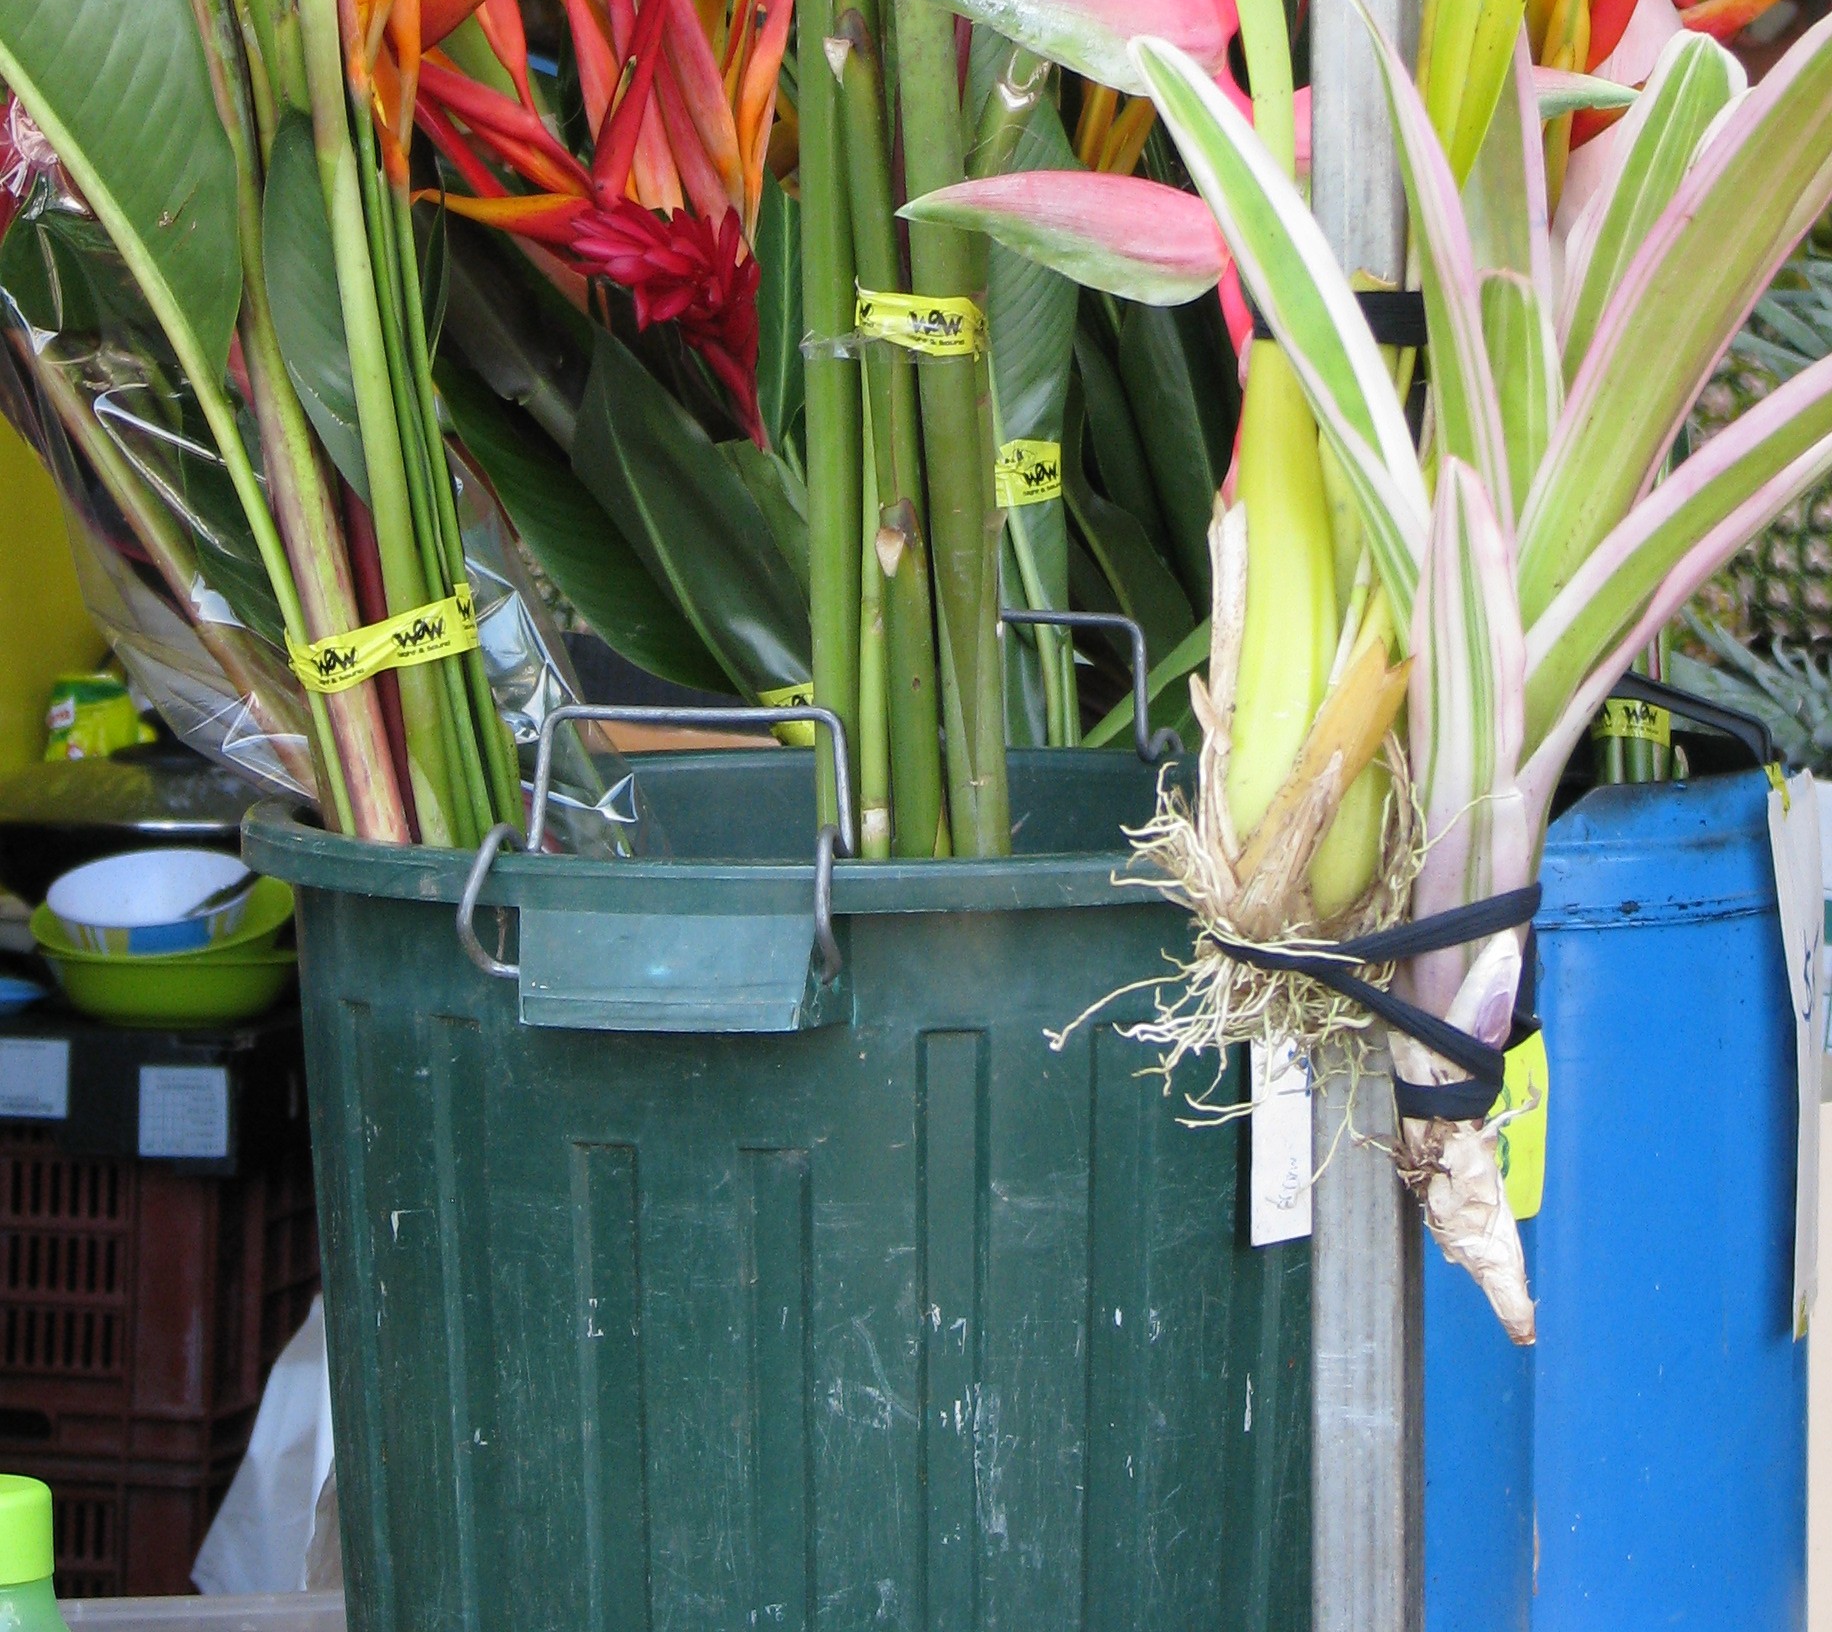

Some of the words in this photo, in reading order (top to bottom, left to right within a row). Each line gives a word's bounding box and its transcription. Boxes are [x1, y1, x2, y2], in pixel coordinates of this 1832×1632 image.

[908, 310, 963, 336] WOW
[1023, 459, 1057, 487] WOW
[393, 616, 445, 649] WOW
[312, 646, 357, 676] WOW
